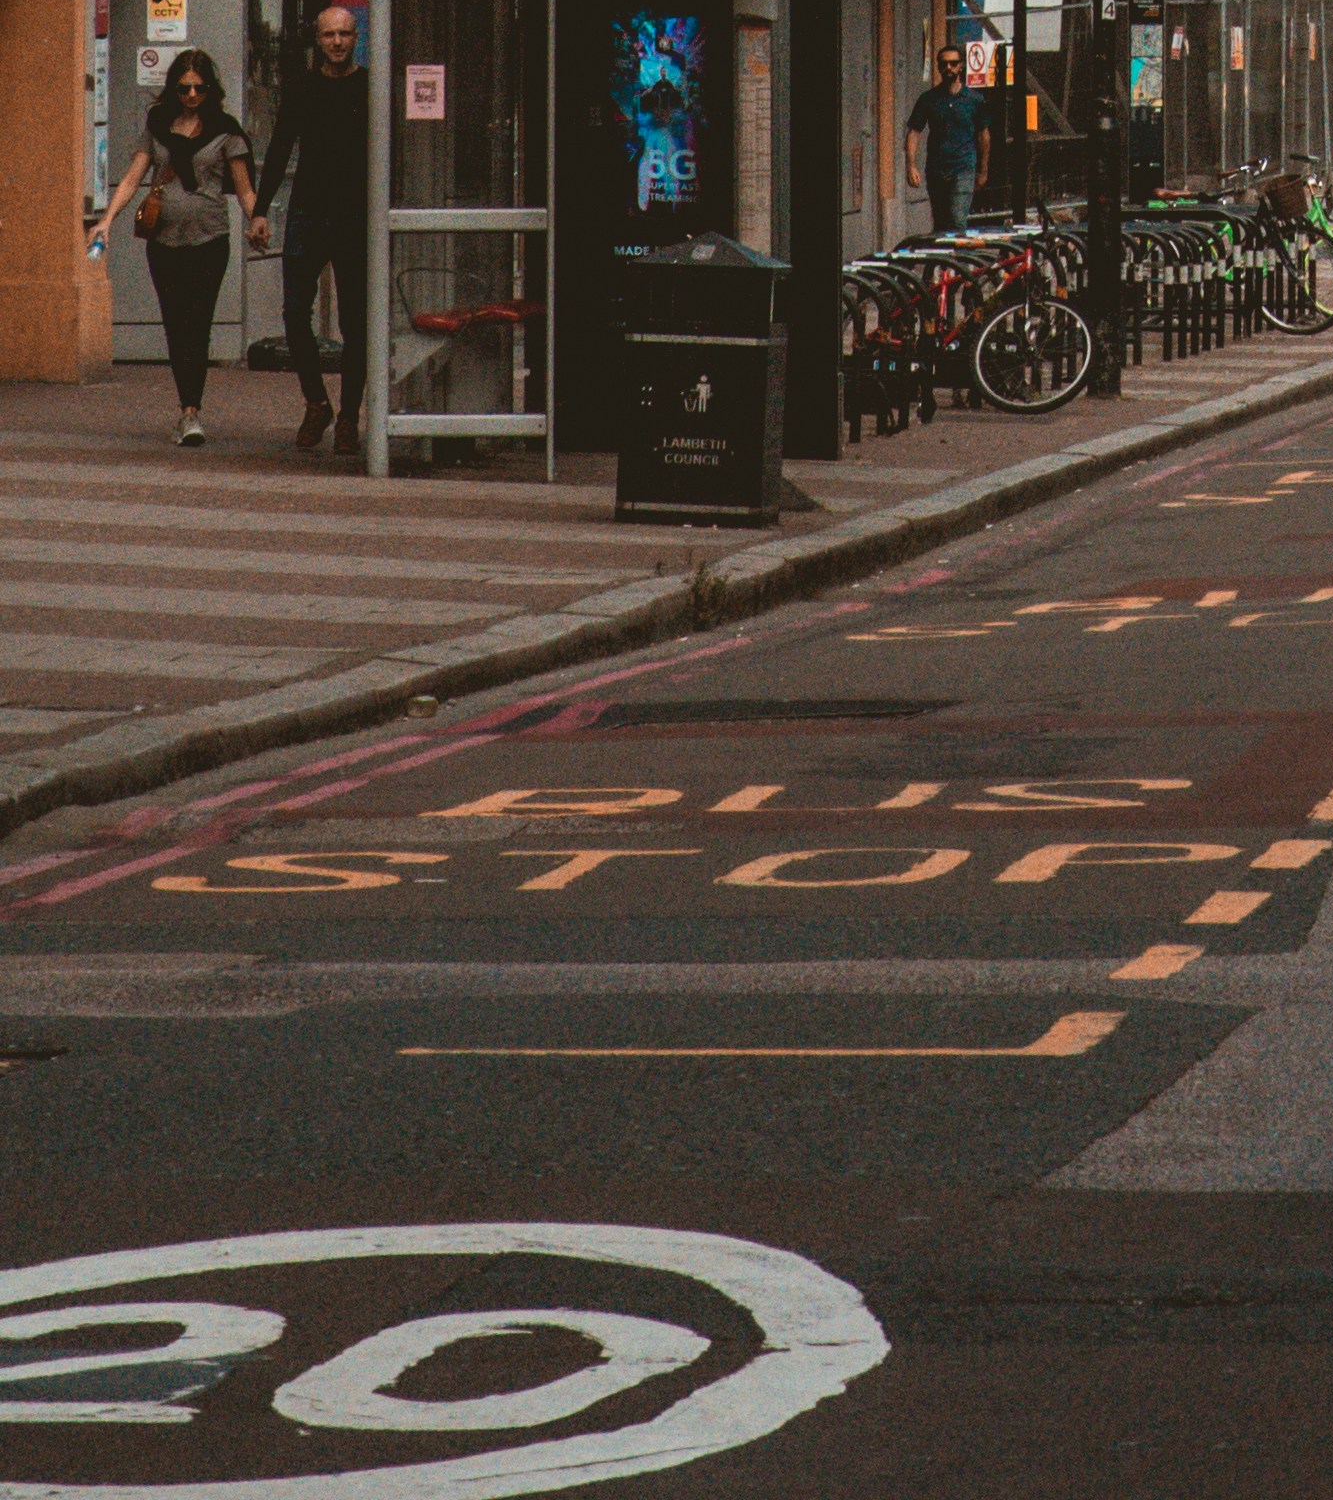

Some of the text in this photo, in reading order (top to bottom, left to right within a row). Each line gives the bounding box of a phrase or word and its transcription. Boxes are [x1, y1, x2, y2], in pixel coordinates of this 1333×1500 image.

[154, 8, 179, 17] CCTV
[1104, 2, 1115, 17] 4
[614, 245, 651, 257] MADE
[662, 436, 727, 450] LAMBETH
[664, 453, 720, 466] COUNCIL
[420, 778, 1194, 819] BUS
[151, 841, 1243, 894] STOP
